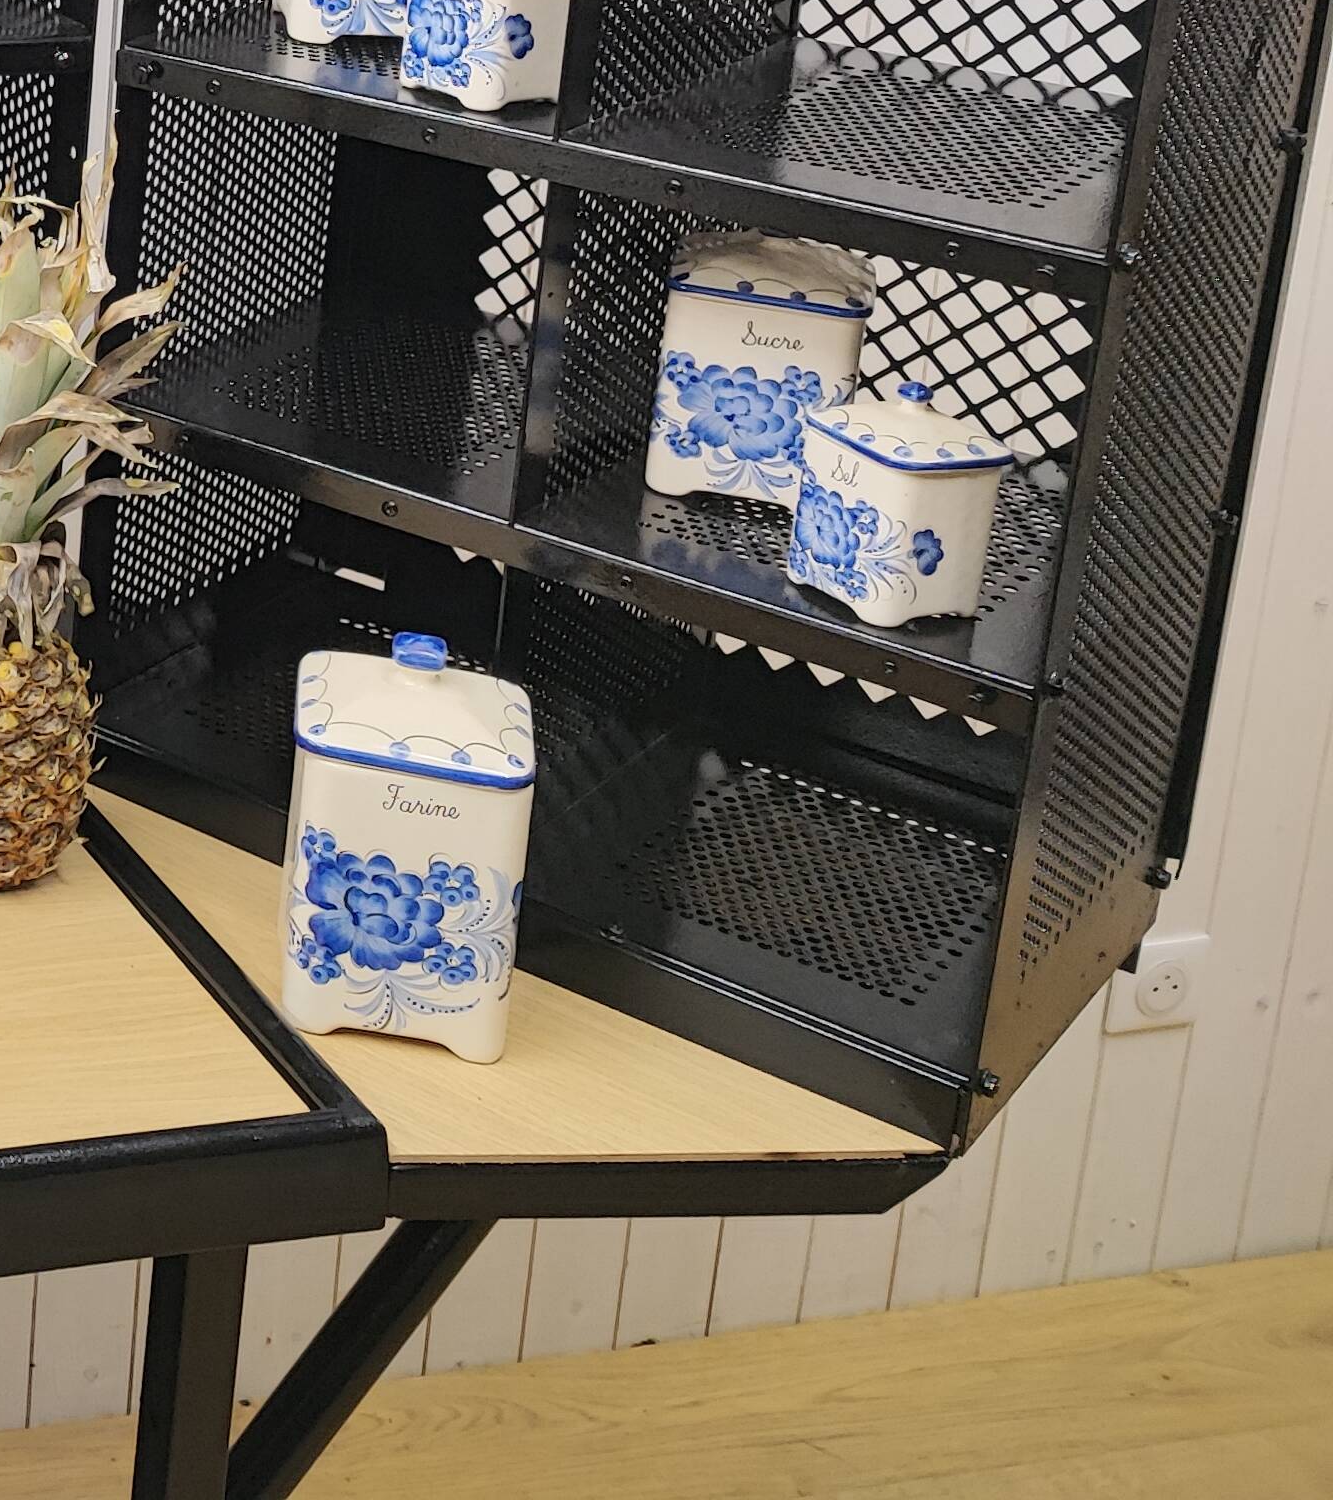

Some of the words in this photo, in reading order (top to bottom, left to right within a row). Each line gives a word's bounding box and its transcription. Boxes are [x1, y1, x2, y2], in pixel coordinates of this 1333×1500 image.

[741, 320, 804, 351] Sucre
[831, 454, 860, 488] Sel
[382, 783, 460, 819] Farine
